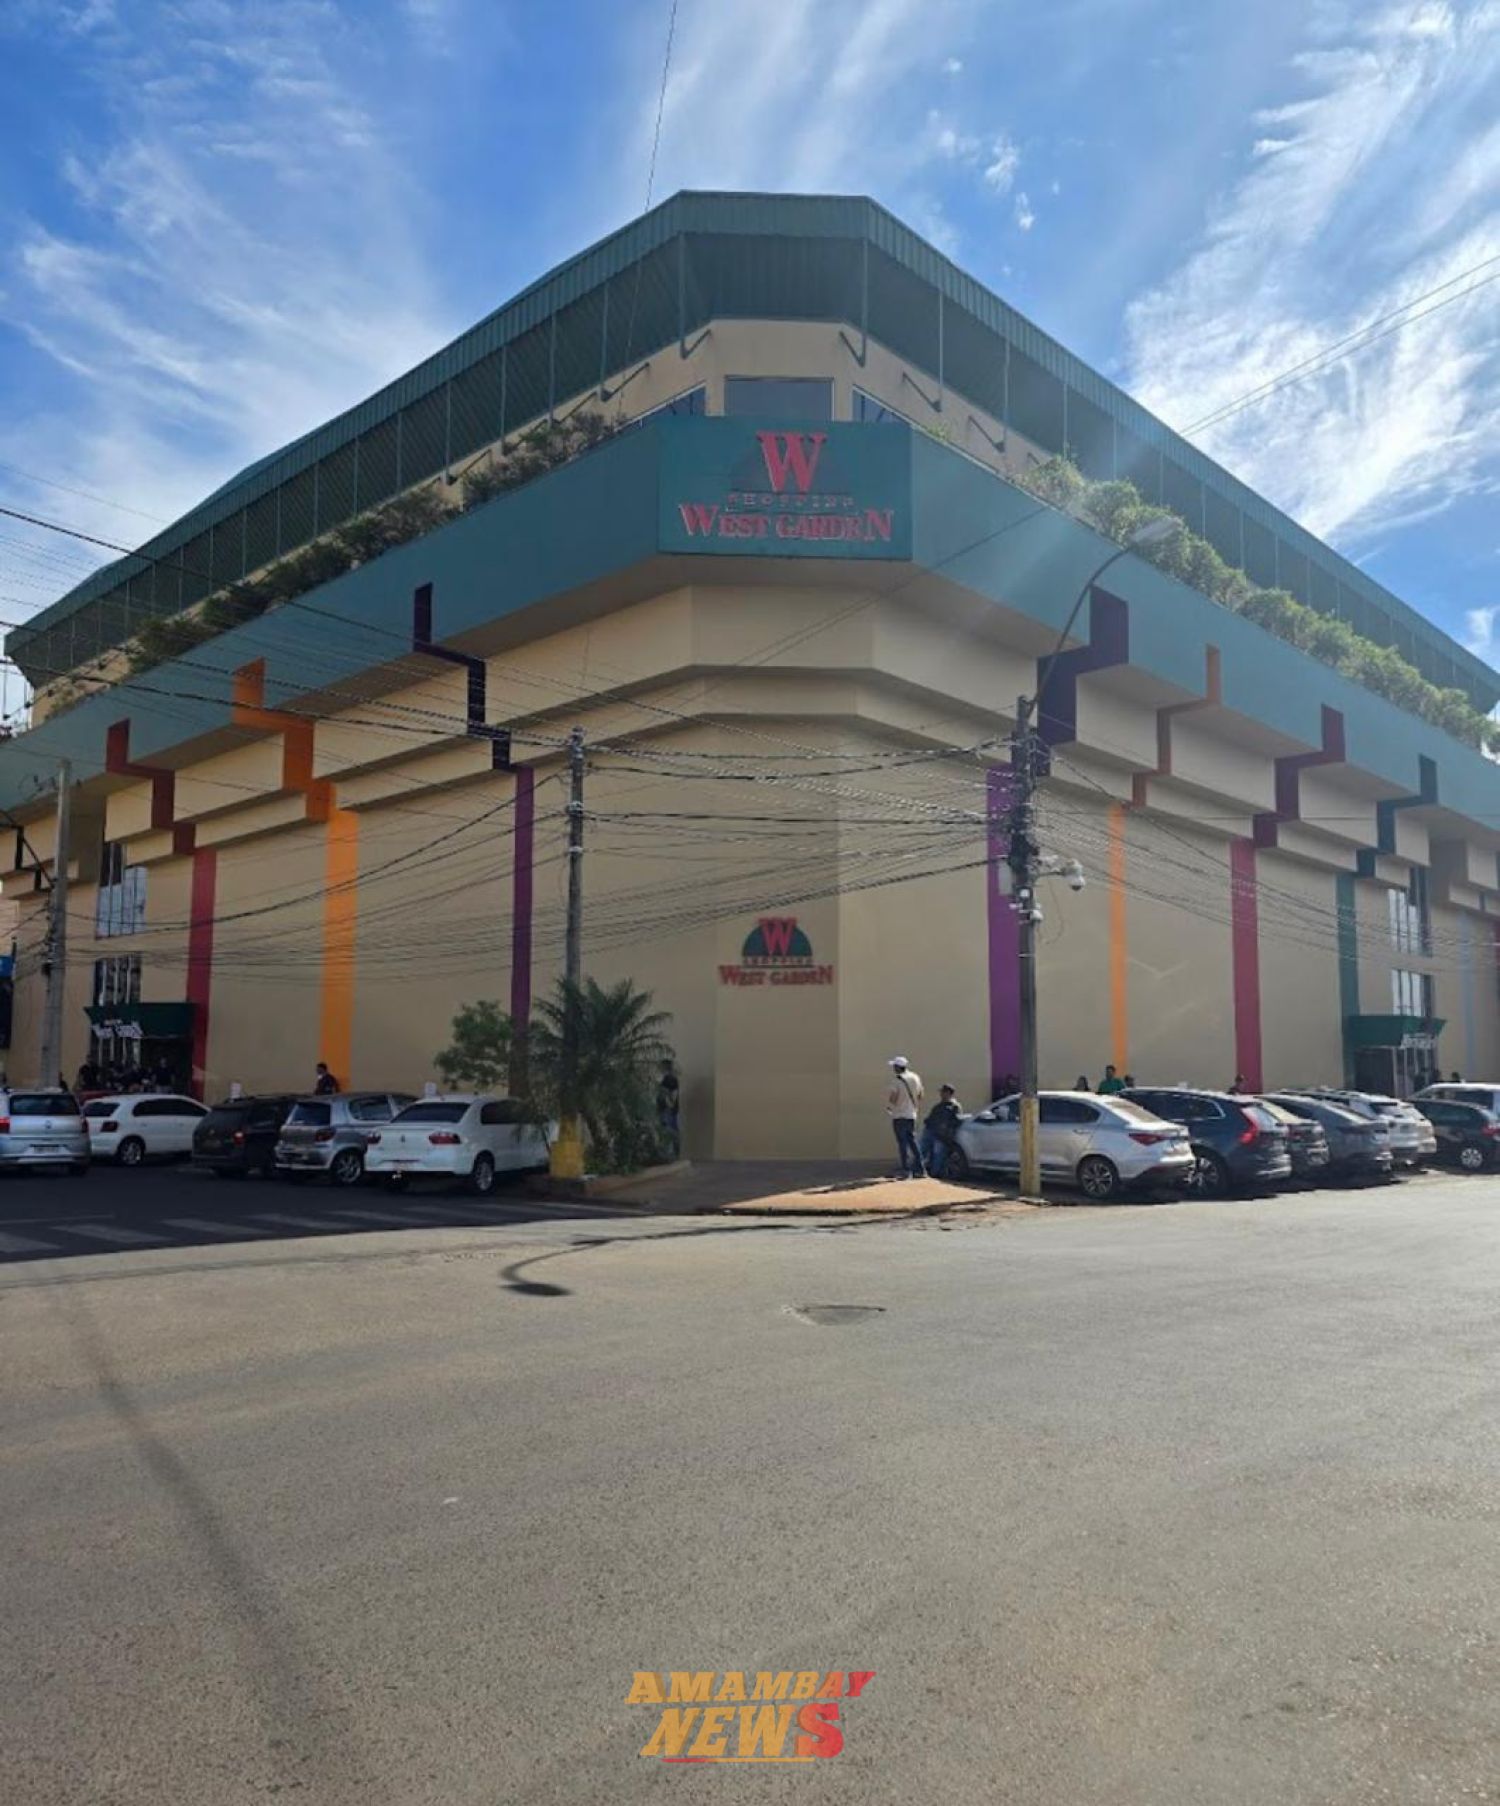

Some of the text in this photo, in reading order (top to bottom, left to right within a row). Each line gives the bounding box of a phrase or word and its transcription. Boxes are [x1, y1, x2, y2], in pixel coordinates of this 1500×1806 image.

[756, 430, 828, 493] W
[678, 503, 895, 542] WEST GARDEN
